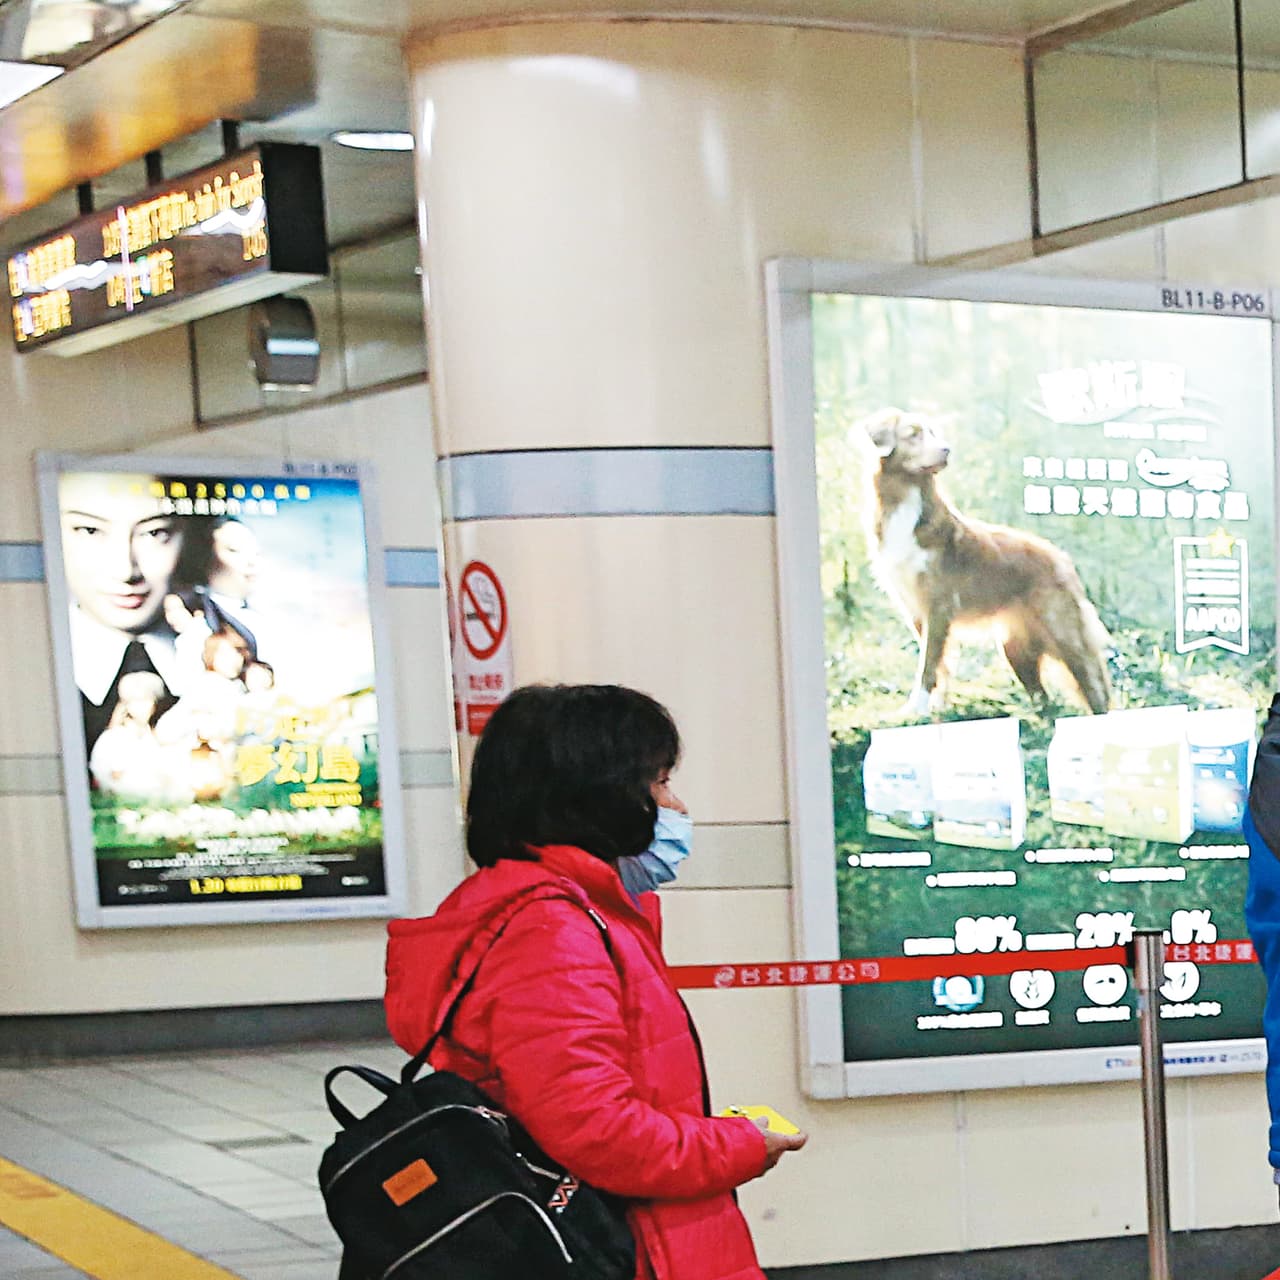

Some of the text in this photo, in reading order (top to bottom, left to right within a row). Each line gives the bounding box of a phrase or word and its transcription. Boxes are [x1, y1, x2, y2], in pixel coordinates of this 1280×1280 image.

[1161, 288, 1265, 313] BL11-B-P06
[740, 961, 881, 985] 台北捷運公司
